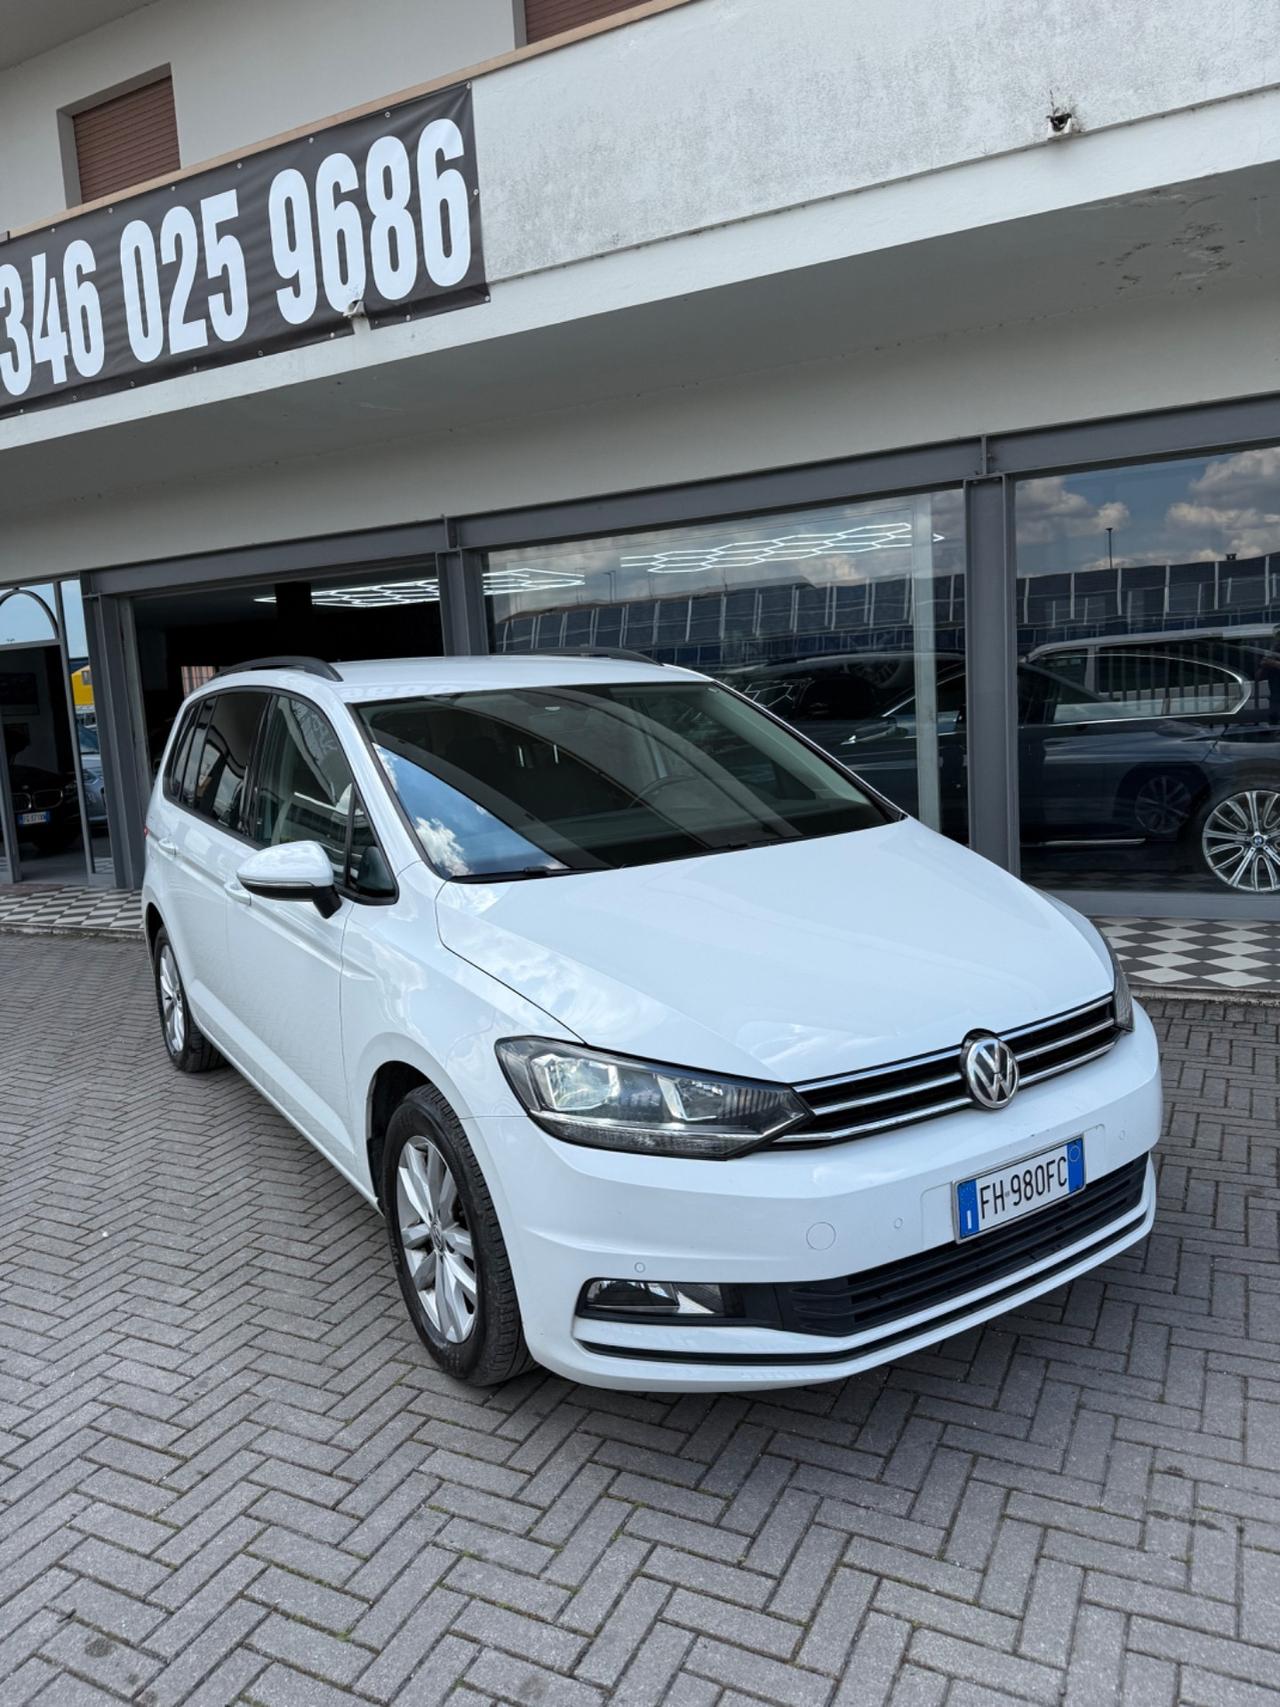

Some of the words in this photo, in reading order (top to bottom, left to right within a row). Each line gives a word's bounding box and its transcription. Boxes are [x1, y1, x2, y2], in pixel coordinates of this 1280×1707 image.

[0, 240, 105, 396] 346
[120, 189, 249, 363] 025
[268, 118, 471, 325] 9686
